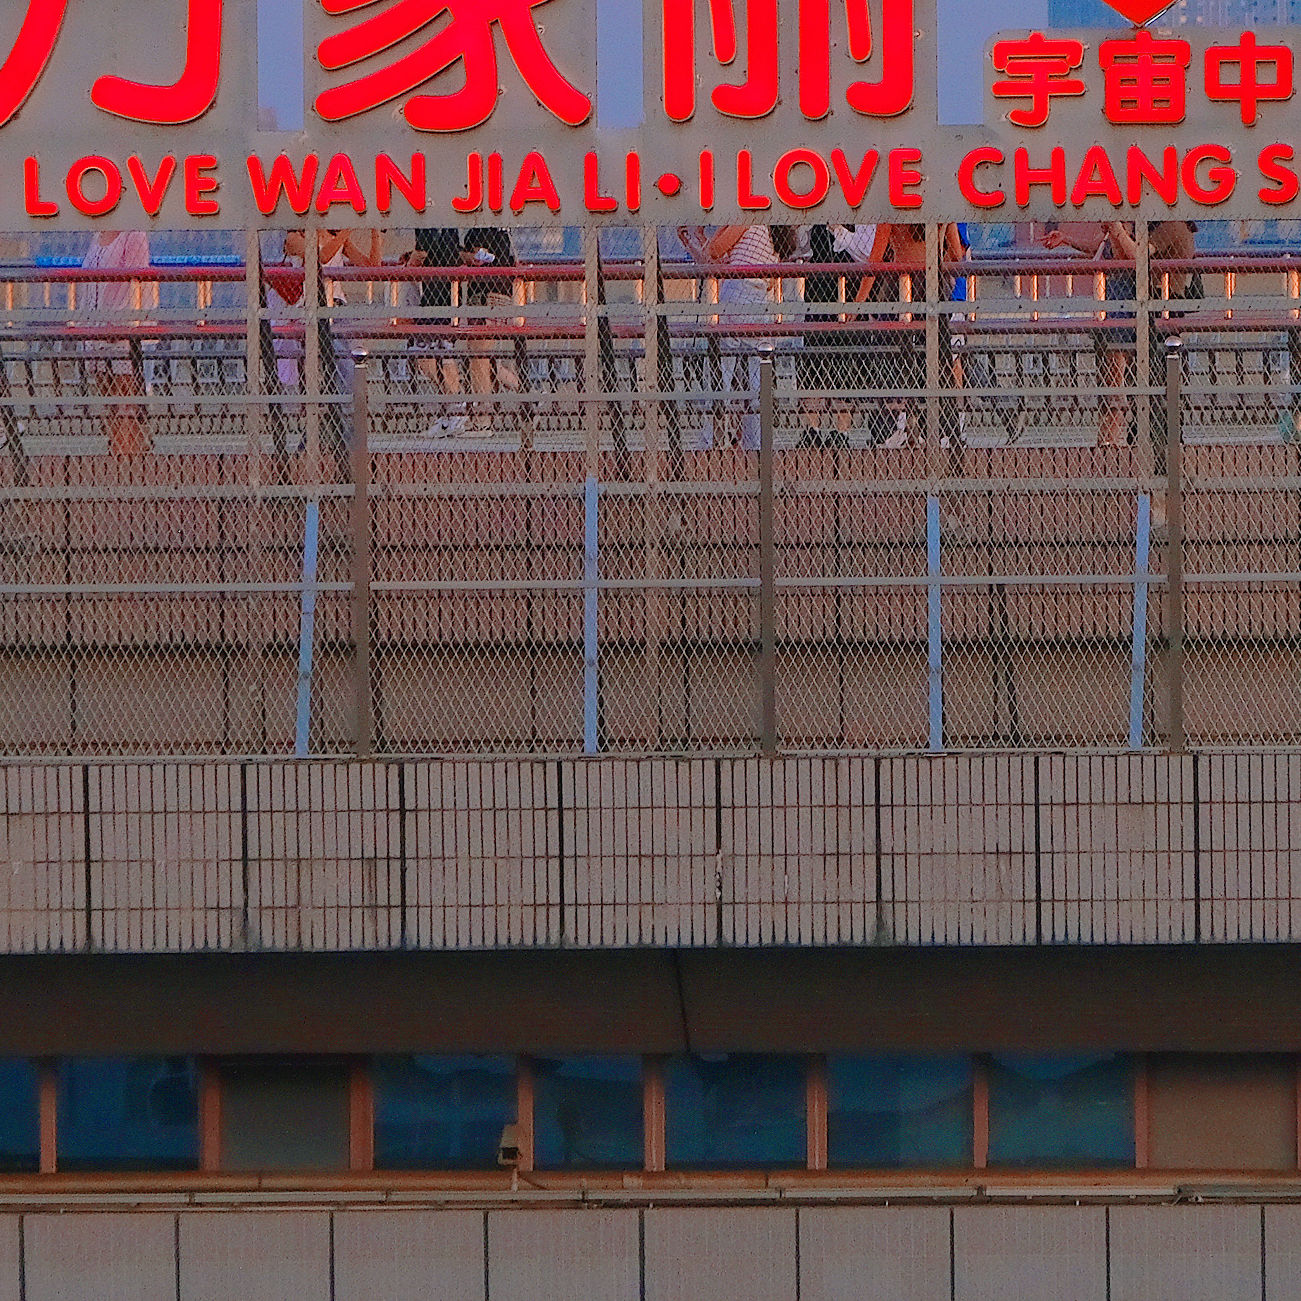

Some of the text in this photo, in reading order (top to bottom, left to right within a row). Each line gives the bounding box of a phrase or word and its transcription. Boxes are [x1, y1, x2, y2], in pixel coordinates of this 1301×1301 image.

[23, 153, 220, 216] LOVE
[245, 152, 427, 215] WAN
[450, 150, 562, 213] JIA
[736, 146, 924, 210] LOVE
[956, 142, 1237, 208] CHANG
